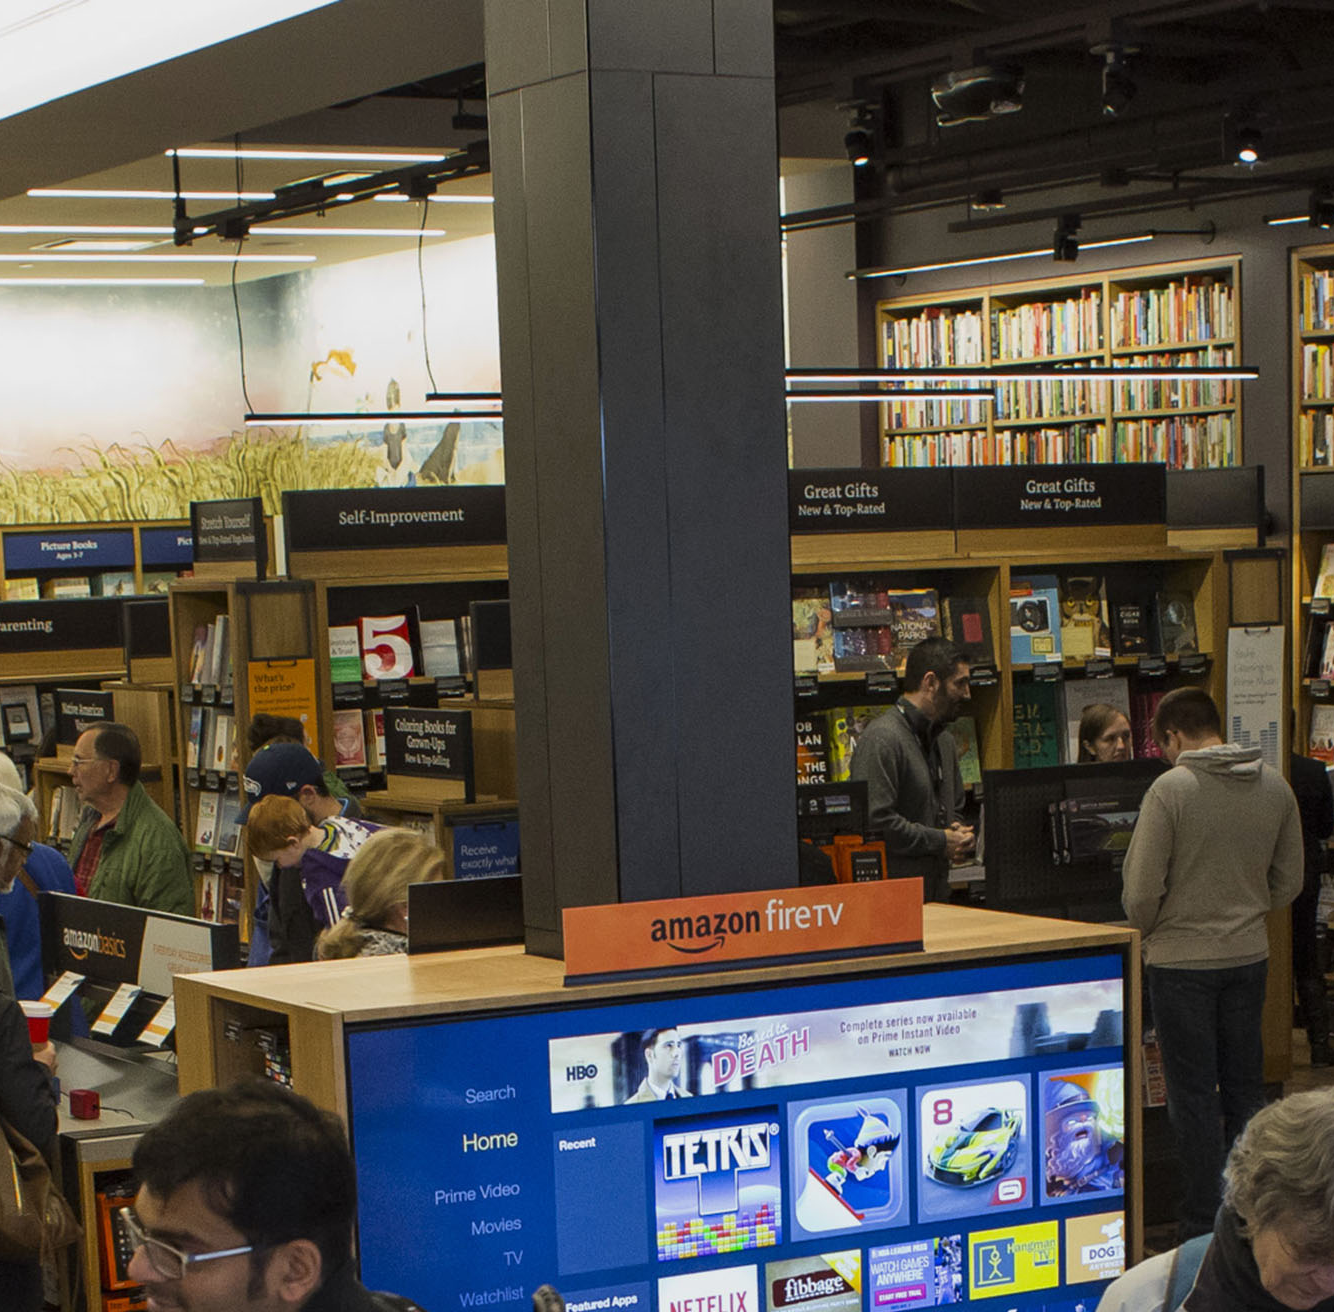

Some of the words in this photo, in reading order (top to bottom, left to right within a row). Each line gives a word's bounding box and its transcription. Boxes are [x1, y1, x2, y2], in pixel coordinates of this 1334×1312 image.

[804, 485, 841, 499] Great
[845, 483, 878, 498] Gifts
[1026, 480, 1062, 494] Great
[1064, 479, 1095, 493] Gifts
[799, 504, 820, 516] New
[834, 502, 885, 517] Top-Rated
[1021, 499, 1040, 510] New
[1054, 497, 1101, 512] Top-Rated
[339, 508, 464, 526] Self-Improvement
[41, 540, 70, 552] Picture
[72, 540, 98, 550] Books
[395, 718, 424, 736] Coloring
[425, 719, 445, 734] Books
[446, 720, 457, 735] for
[407, 736, 446, 753] Grown-Ups
[651, 910, 761, 947] amazon
[840, 1018, 883, 1034] Complete
[886, 1013, 913, 1029] series
[916, 1013, 934, 1025] now
[936, 1008, 977, 1023] available
[857, 1035, 869, 1046] on
[872, 1029, 899, 1044] Prime
[902, 1027, 932, 1041] Instant
[935, 1024, 961, 1038] Video
[712, 1027, 809, 1087] DEATH
[888, 1046, 912, 1058] WATCH
[914, 1045, 931, 1056] NOW
[566, 1064, 598, 1082] HBO
[465, 1084, 516, 1104] Search
[933, 1099, 953, 1126] 8
[463, 1132, 518, 1153] Home
[559, 1138, 596, 1152] Recent
[434, 1189, 477, 1206] Prime
[479, 1183, 520, 1200] Video
[471, 1218, 523, 1237] Movies
[503, 1250, 524, 1265] TV
[783, 1271, 844, 1299] fibbage
[459, 1286, 524, 1308] Watchlist
[612, 1293, 638, 1310] Apps
